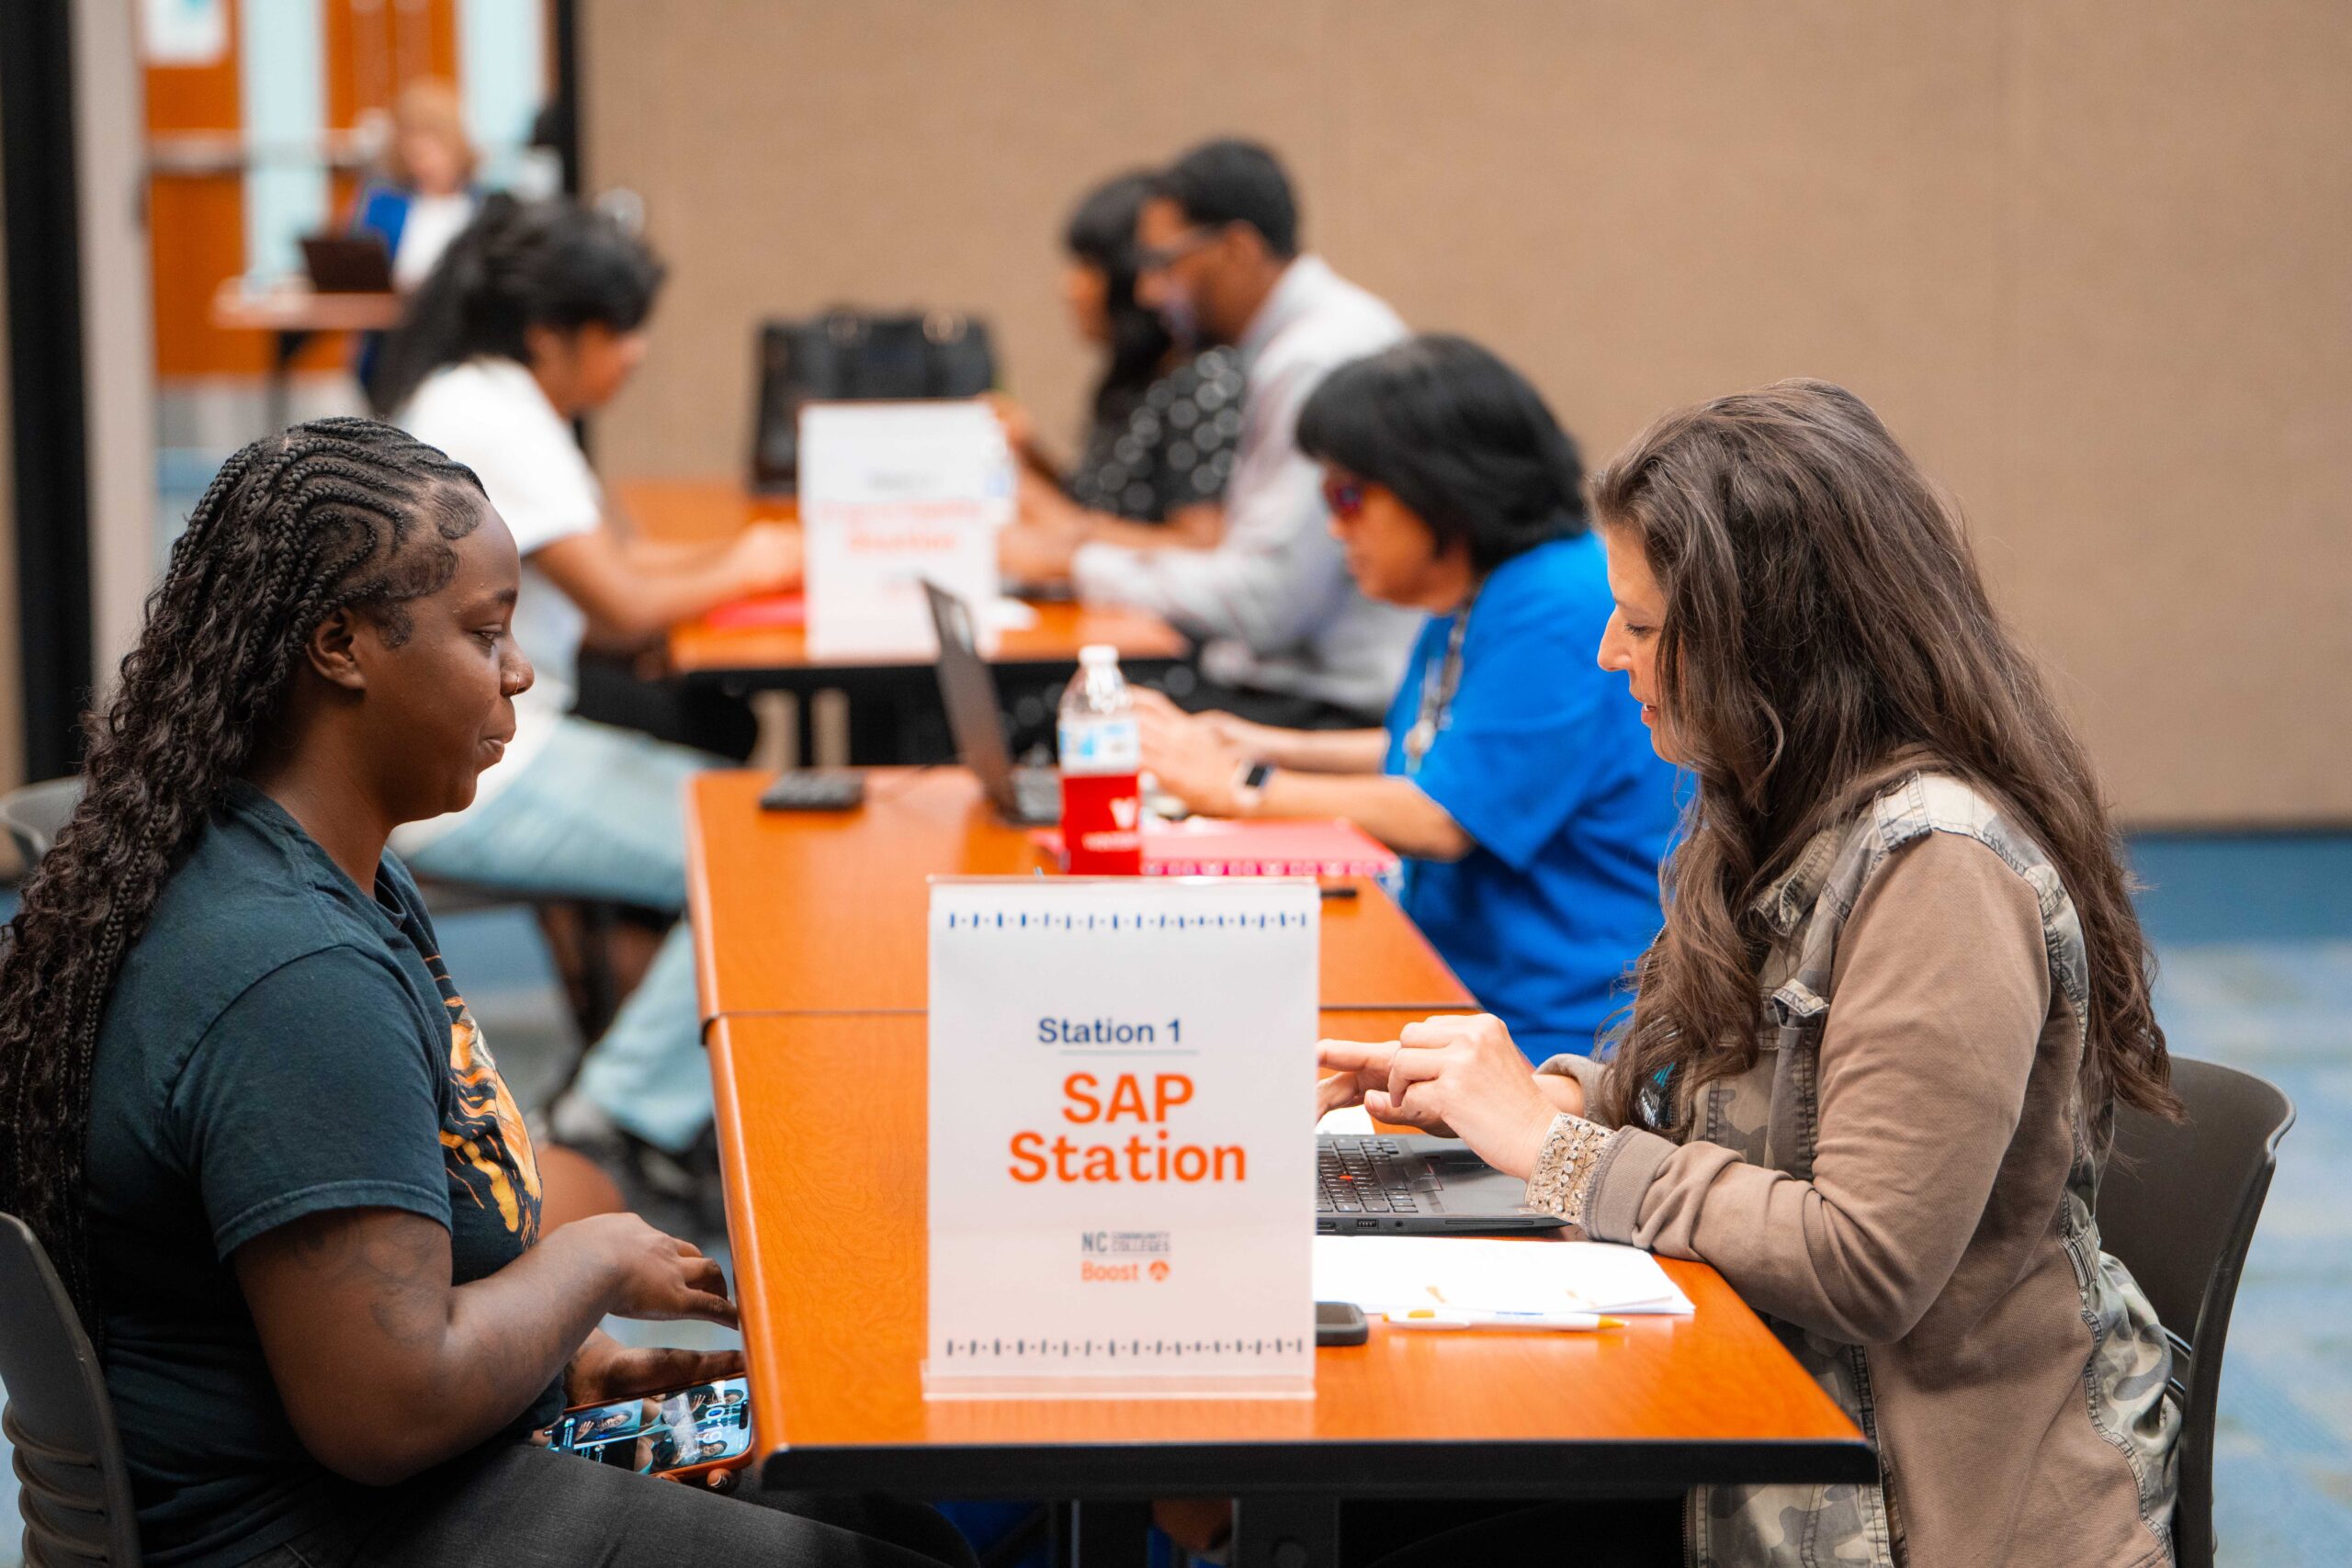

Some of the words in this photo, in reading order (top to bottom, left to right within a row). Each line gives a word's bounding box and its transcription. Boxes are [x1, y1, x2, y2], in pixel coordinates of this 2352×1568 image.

[1038, 1018, 1154, 1043] Station
[1168, 1019, 1182, 1043] 1
[1061, 1071, 1194, 1125] SAP
[1007, 1130, 1248, 1184] Station
[1082, 1232, 1107, 1252] NC
[1081, 1261, 1139, 1281] Boost
[695, 1403, 726, 1444] 10:19
